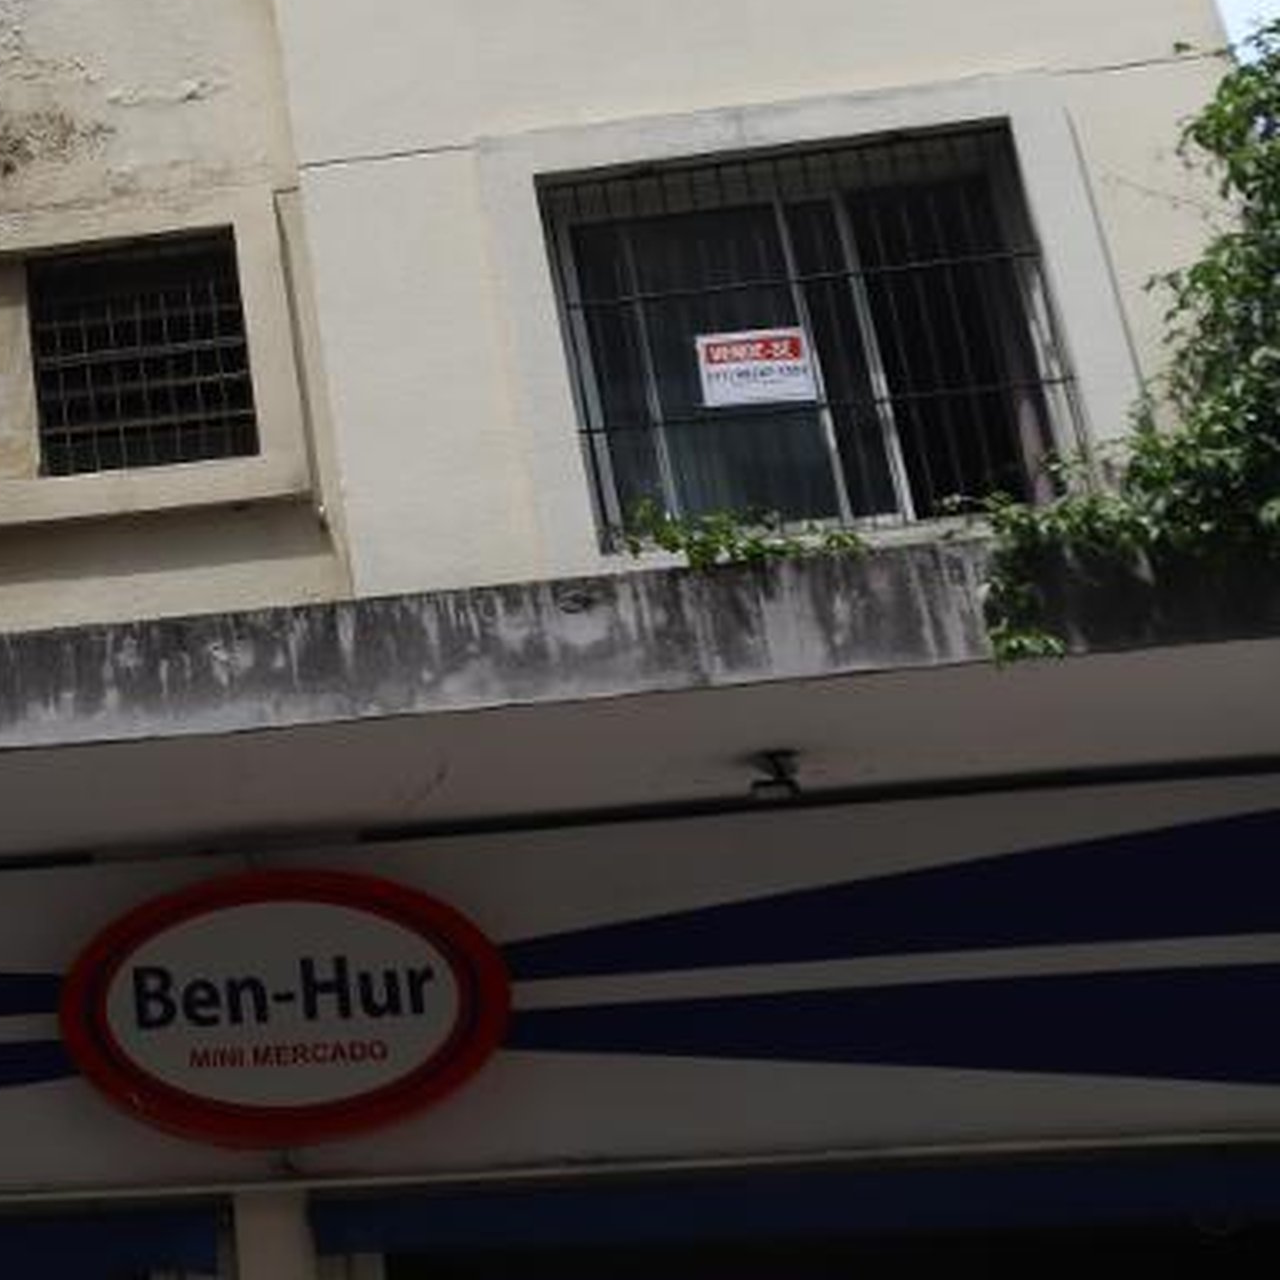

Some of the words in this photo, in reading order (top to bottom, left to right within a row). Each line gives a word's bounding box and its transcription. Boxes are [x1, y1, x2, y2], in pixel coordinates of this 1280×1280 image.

[132, 955, 435, 1030] Ben-Hur
[189, 1047, 246, 1069] MINI
[251, 1039, 388, 1067] MERCADO
